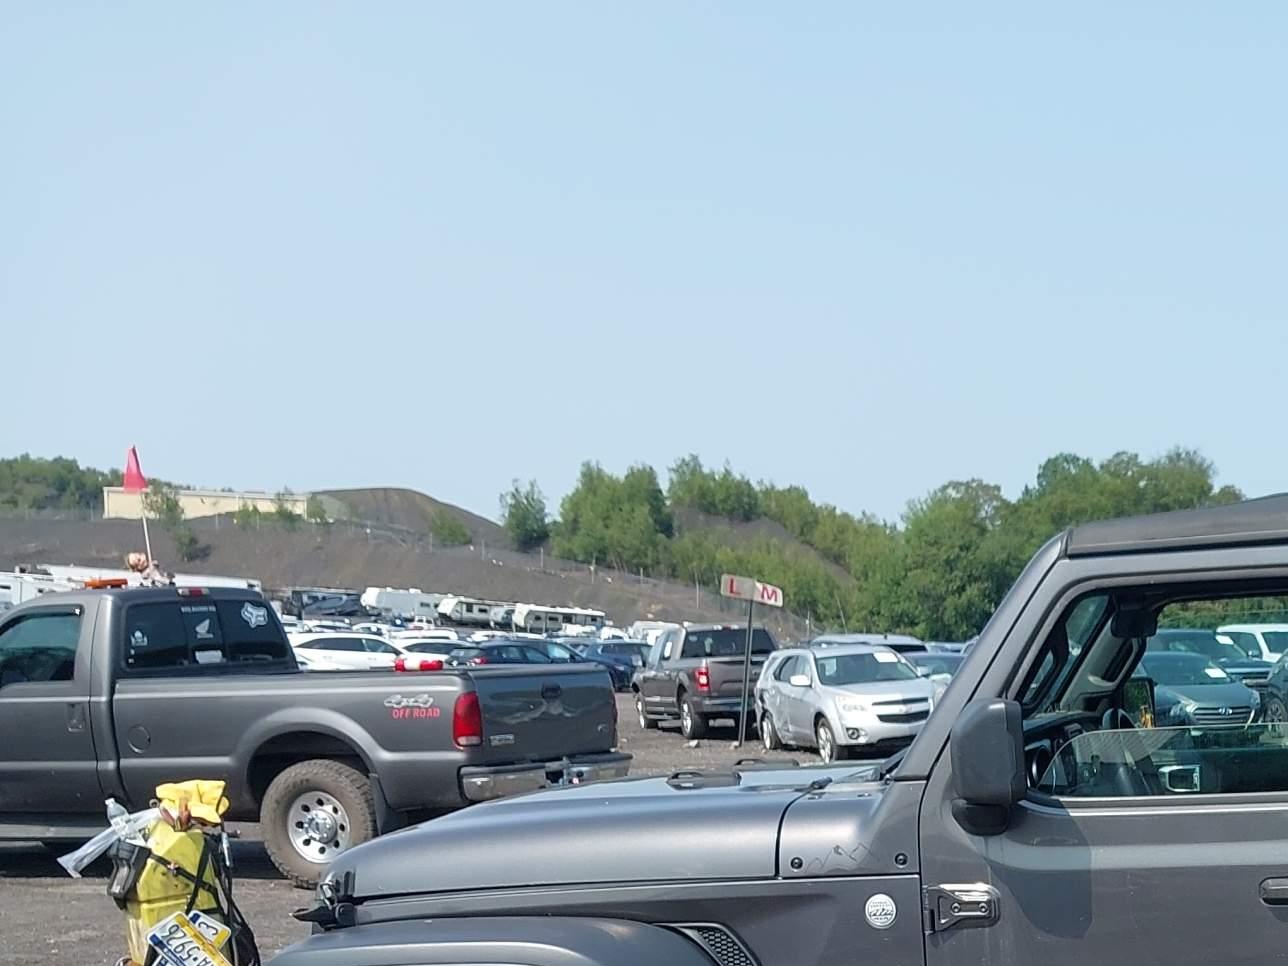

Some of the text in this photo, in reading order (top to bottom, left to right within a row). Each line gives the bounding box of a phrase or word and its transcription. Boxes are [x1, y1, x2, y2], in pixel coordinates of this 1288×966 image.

[729, 578, 778, 602] L M
[392, 707, 440, 719] OFF ROAD
